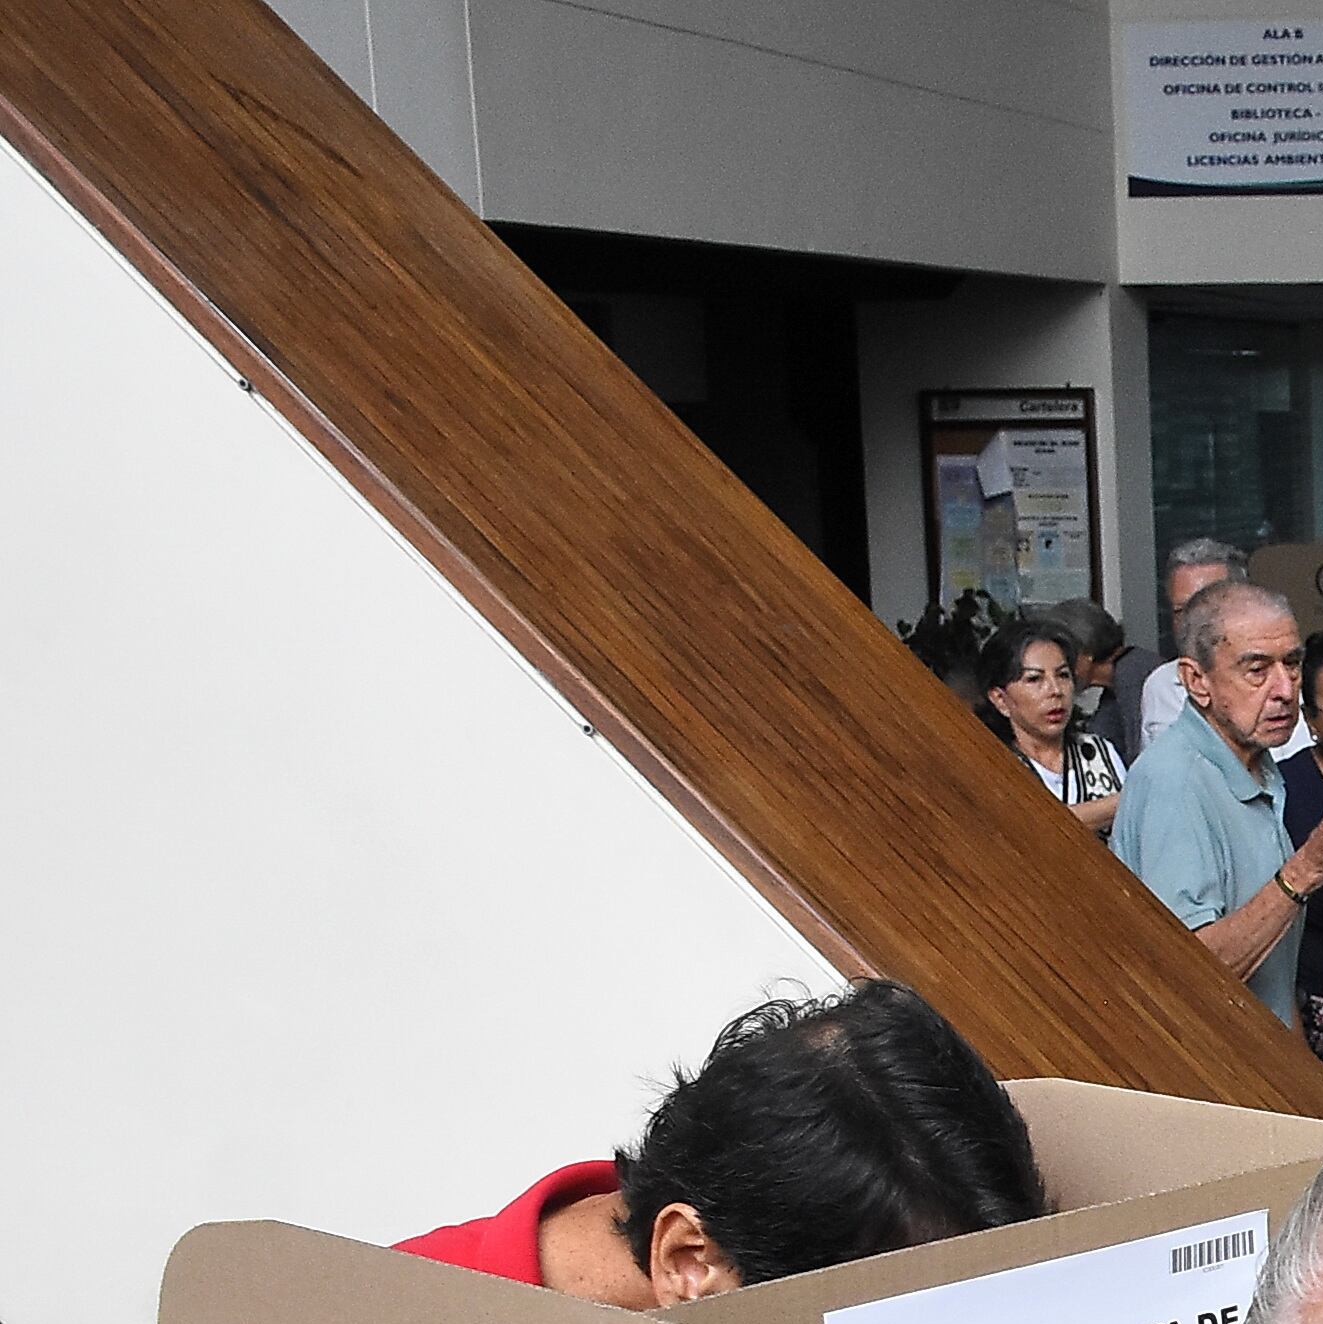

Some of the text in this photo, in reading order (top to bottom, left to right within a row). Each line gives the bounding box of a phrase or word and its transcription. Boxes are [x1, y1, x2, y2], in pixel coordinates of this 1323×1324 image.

[1263, 29, 1290, 39] ALA
[1150, 55, 1226, 67] DIRECCIÓN
[1230, 55, 1246, 66] DE
[1251, 53, 1313, 65] GESTIÓN
[1163, 84, 1221, 95] OFICINA
[1224, 83, 1241, 94] DE
[1246, 82, 1313, 94] CONTROL
[1231, 108, 1312, 120] BIBLIOTECA
[1209, 132, 1266, 143] OFICINA
[1187, 155, 1259, 166] LICENCIAS
